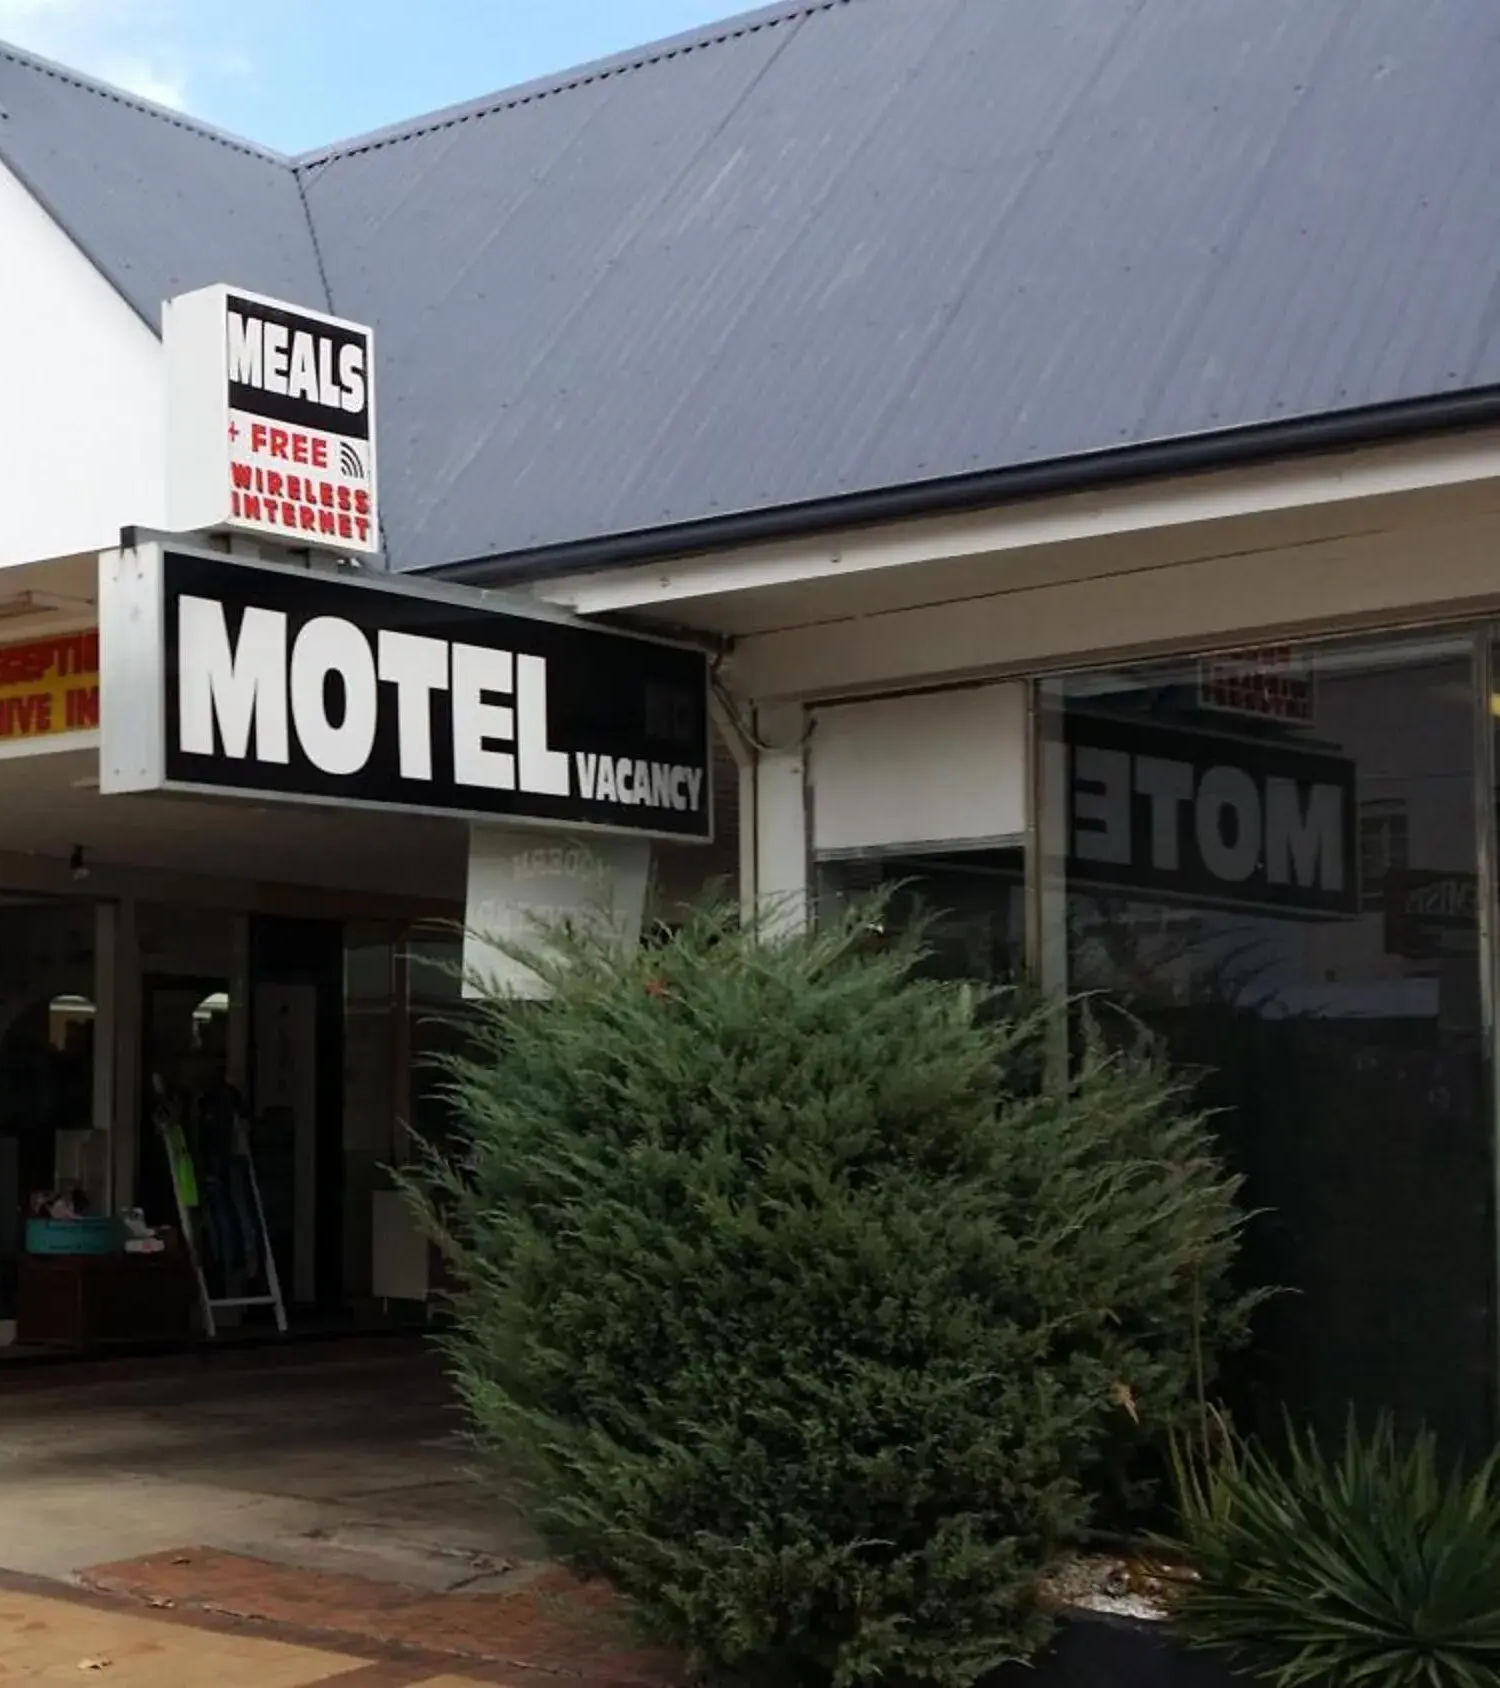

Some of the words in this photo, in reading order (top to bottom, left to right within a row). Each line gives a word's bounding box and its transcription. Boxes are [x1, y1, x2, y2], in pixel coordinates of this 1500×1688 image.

[228, 311, 365, 413] MEALS
[251, 423, 327, 468] FREE
[230, 462, 368, 514] WIRELESS
[232, 491, 369, 542] INTERNET
[178, 594, 569, 797] MOTEL
[575, 751, 703, 812] VACANCY
